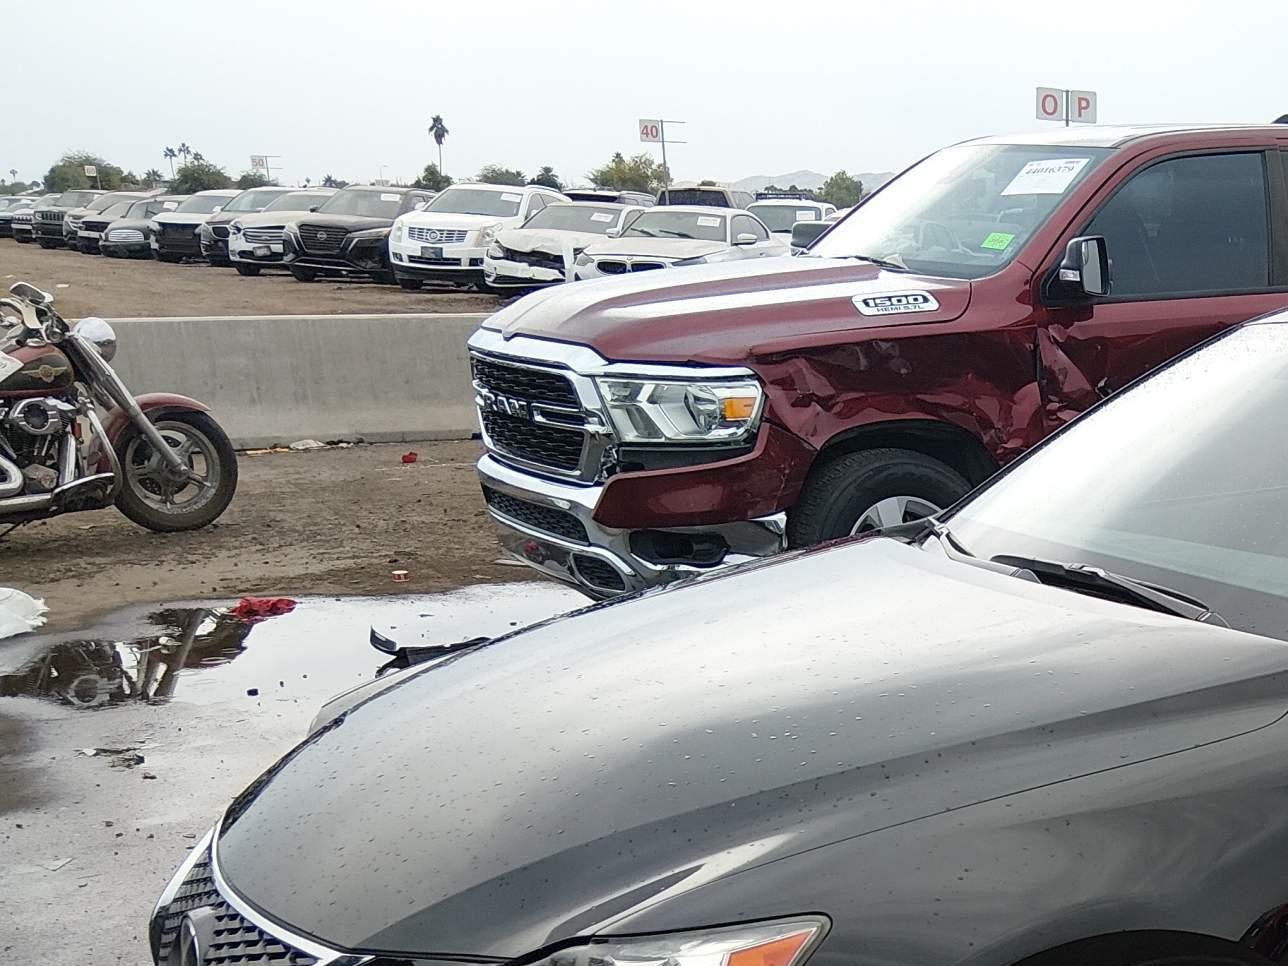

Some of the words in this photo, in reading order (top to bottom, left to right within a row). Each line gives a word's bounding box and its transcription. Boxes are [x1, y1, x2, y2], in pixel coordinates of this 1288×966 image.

[1041, 94, 1058, 116] O
[1077, 96, 1091, 118] P
[641, 124, 659, 138] 40
[864, 295, 924, 307] 1500
